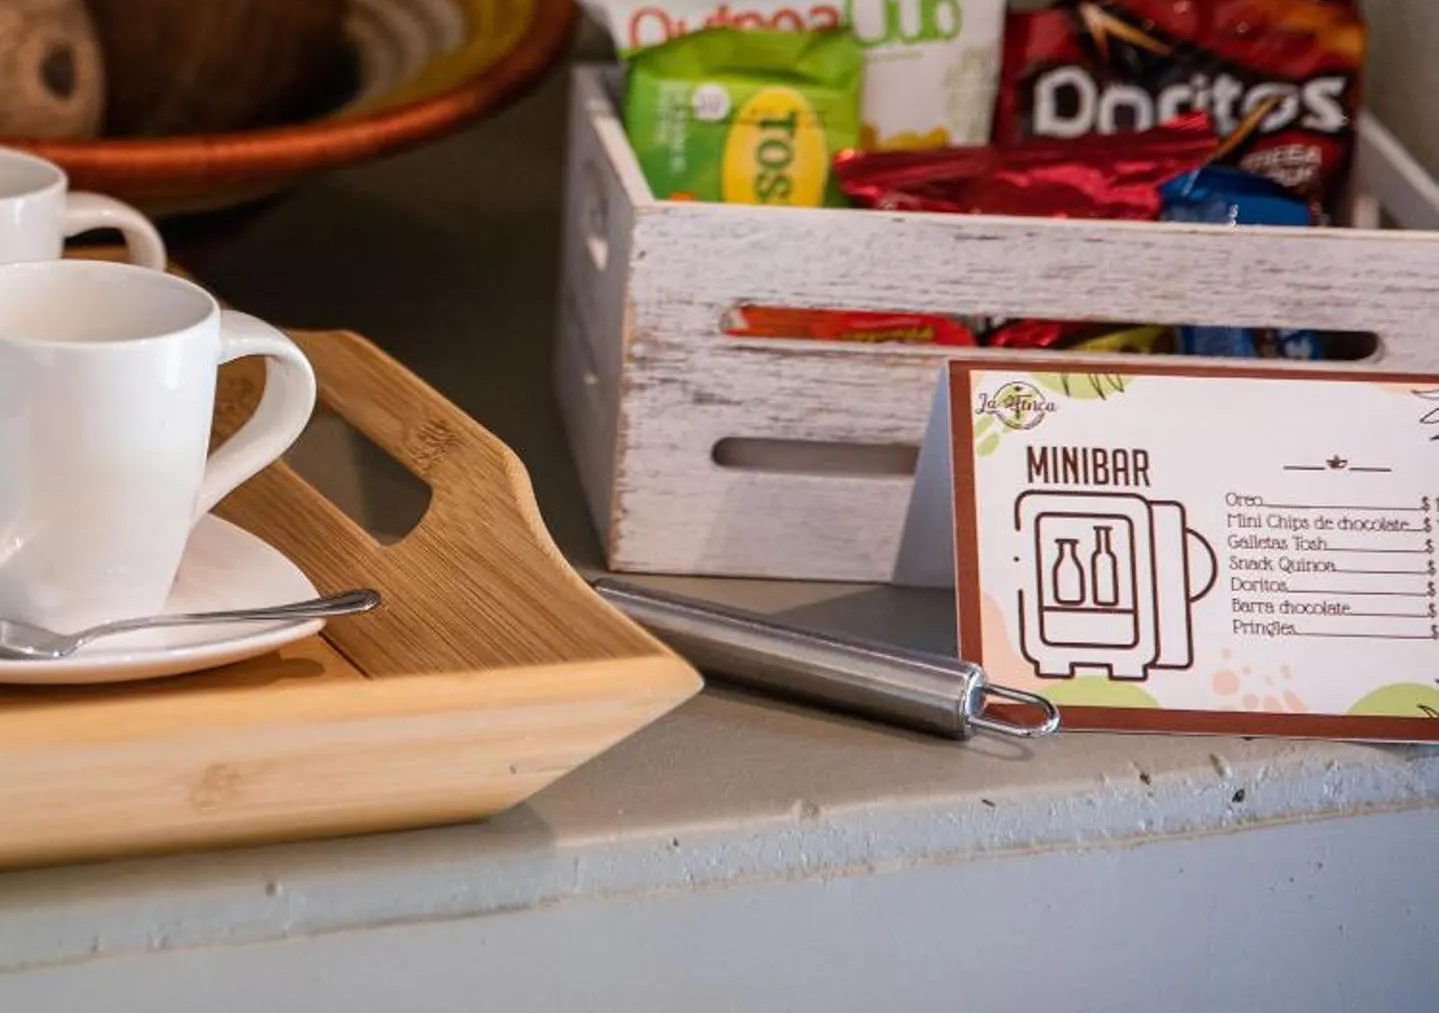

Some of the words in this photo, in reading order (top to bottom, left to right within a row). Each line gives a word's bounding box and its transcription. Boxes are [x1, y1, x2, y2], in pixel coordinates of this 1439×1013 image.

[1033, 65, 1348, 139] Doritos
[755, 110, 800, 200] TOS
[1026, 445, 1151, 487] MINIBAR
[1225, 492, 1263, 507] Oreo
[1227, 513, 1262, 529] Mini
[1266, 514, 1310, 532] Chips
[1314, 515, 1334, 530] de
[1337, 517, 1410, 532] chocolate
[1227, 534, 1288, 550] Galletas
[1292, 536, 1328, 551] Tosh
[1229, 556, 1273, 572] Snack
[1278, 556, 1336, 574] Quinoa
[1231, 577, 1288, 593] Doritos
[1231, 598, 1274, 614] Barra
[1279, 600, 1352, 616] chocolate
[1233, 619, 1296, 637] Pringles
